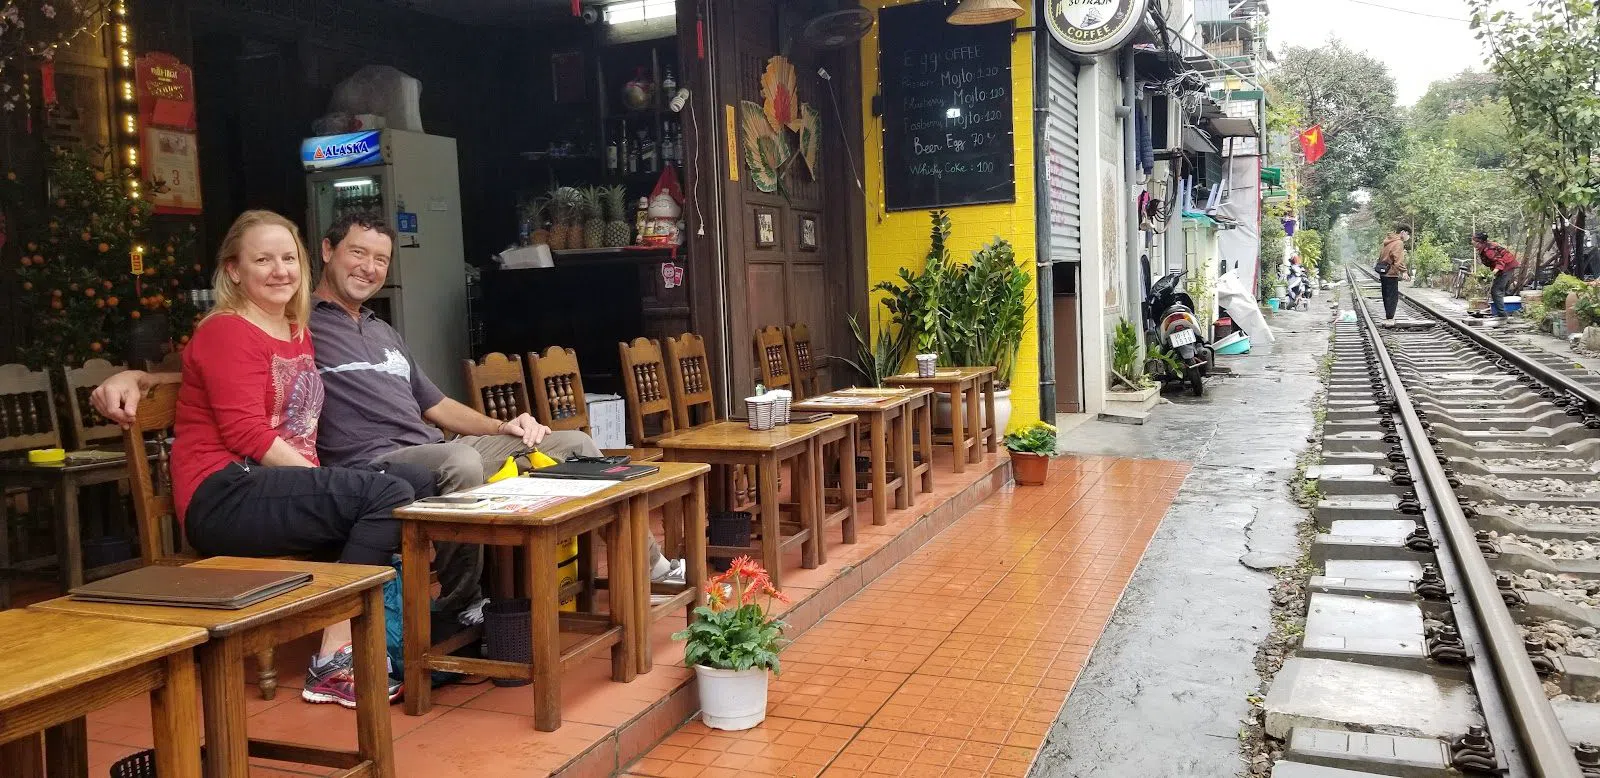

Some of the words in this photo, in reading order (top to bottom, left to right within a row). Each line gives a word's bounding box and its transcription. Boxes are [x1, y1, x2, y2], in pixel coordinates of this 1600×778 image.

[1067, 25, 1111, 39] COFFEE
[325, 140, 369, 157] ALASKA
[976, 161, 994, 173] 100
[172, 169, 180, 186] 3
